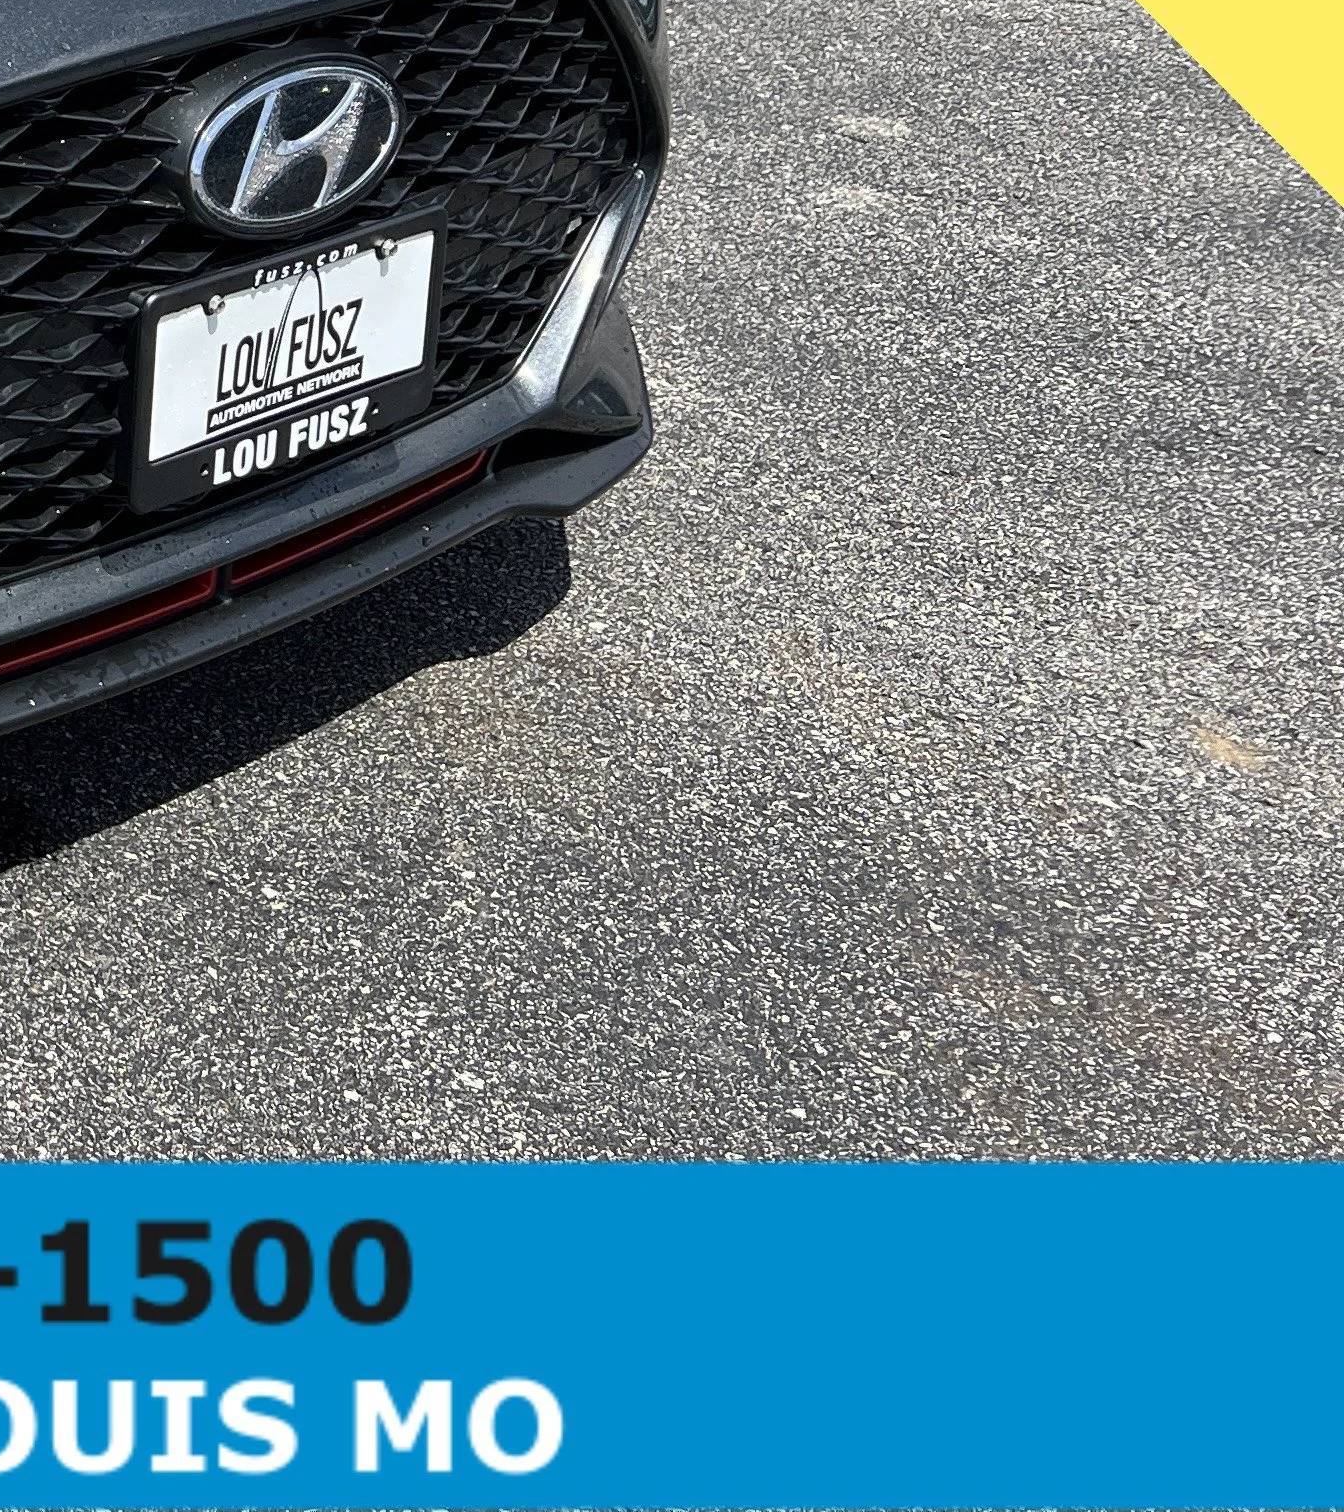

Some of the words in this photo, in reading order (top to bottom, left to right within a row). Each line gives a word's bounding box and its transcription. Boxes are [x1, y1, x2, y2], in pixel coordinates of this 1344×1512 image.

[254, 243, 358, 287] fusz.com
[217, 327, 276, 403] LOU
[286, 297, 364, 380] FUSZ
[210, 386, 294, 429] AUTOMOTIVE
[296, 363, 361, 396] NETWORK
[212, 429, 278, 486] LOU
[288, 396, 370, 459] FUSZ
